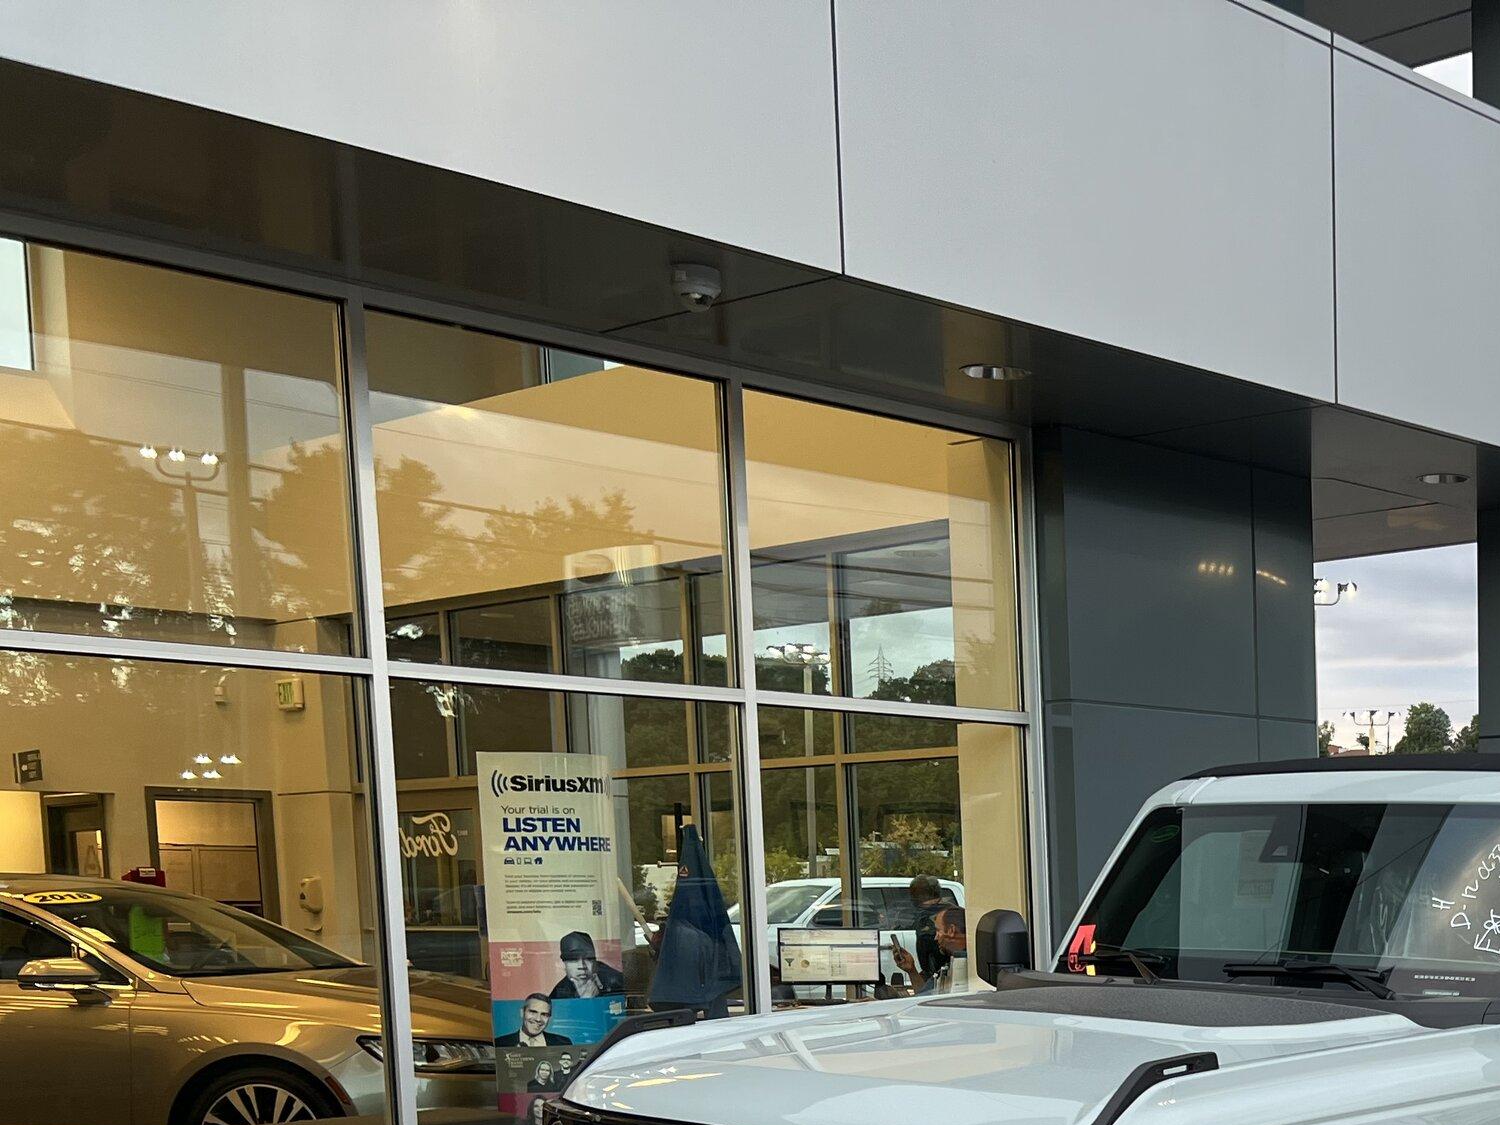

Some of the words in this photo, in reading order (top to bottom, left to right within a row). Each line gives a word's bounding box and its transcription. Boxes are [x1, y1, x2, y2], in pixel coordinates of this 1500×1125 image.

[501, 805, 525, 815] Your
[529, 804, 548, 814] trial
[552, 805, 560, 814] is
[502, 817, 581, 833] LISTEN
[504, 836, 611, 852] ANYWHERE
